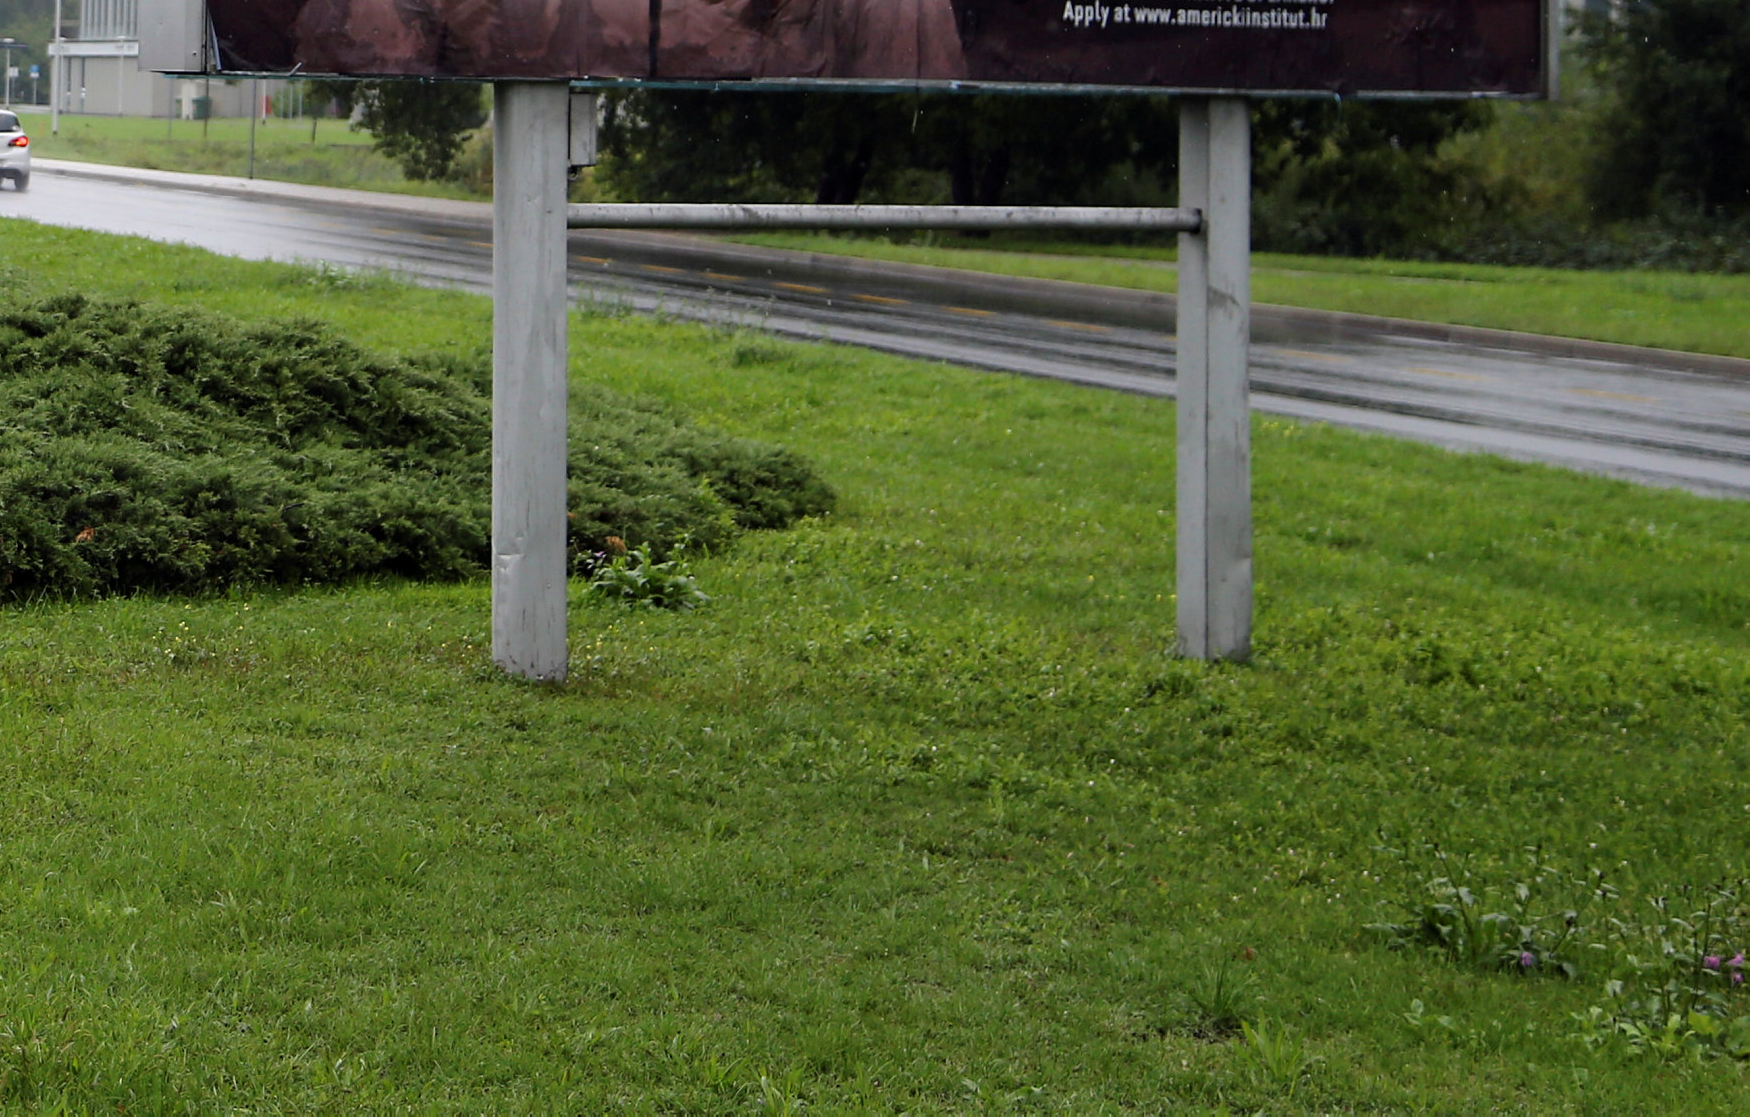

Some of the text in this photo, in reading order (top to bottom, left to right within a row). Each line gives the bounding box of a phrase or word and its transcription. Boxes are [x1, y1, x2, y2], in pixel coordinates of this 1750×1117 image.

[1062, 0, 1328, 29] Apply at www.americkiinstitut.hr
